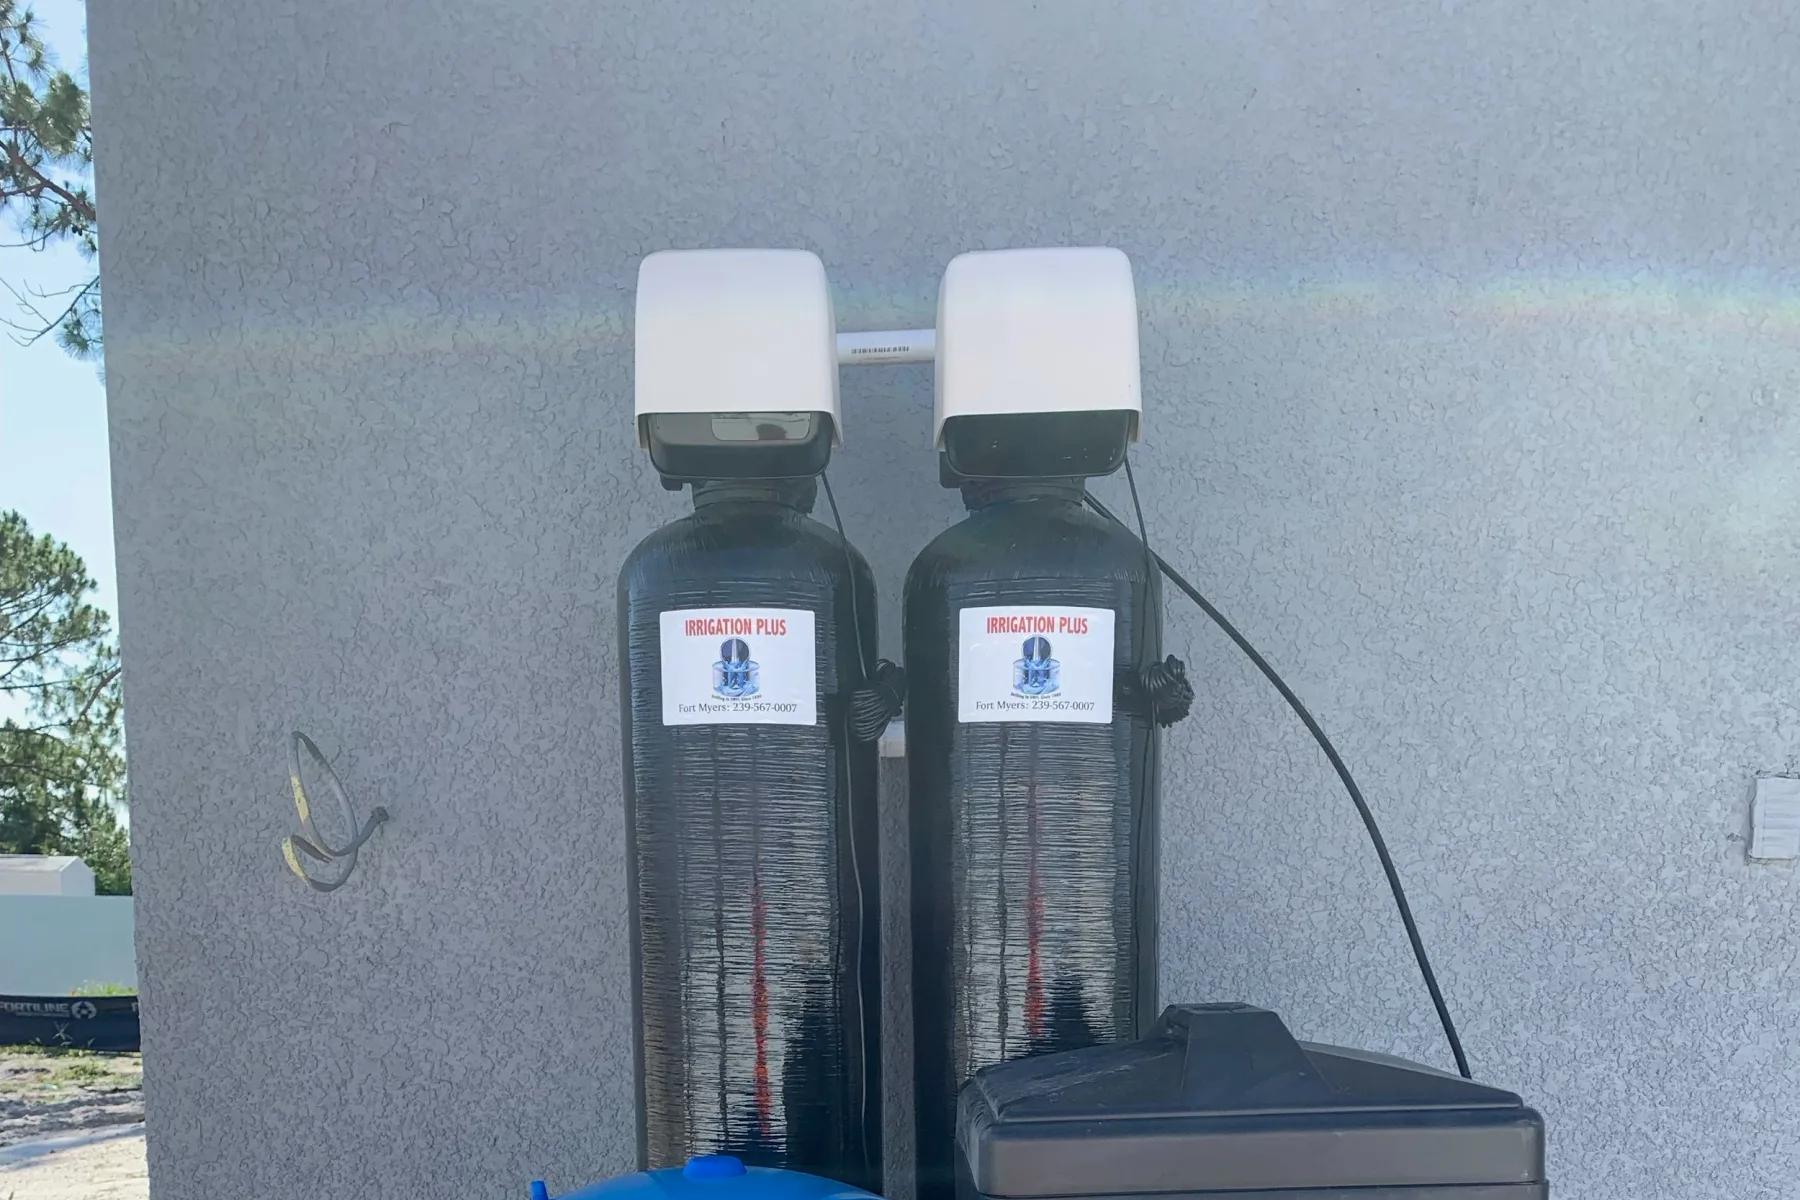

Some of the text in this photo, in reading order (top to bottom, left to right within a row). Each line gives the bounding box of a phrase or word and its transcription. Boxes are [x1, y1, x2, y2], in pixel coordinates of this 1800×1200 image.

[685, 618, 787, 636] IRRIGATION PLUS
[986, 616, 1088, 634] IRRIGATION PLUS
[678, 702, 797, 714] Fort Myers: 239-567-0007
[976, 700, 1095, 712] Fort Myers: 239-567-0007
